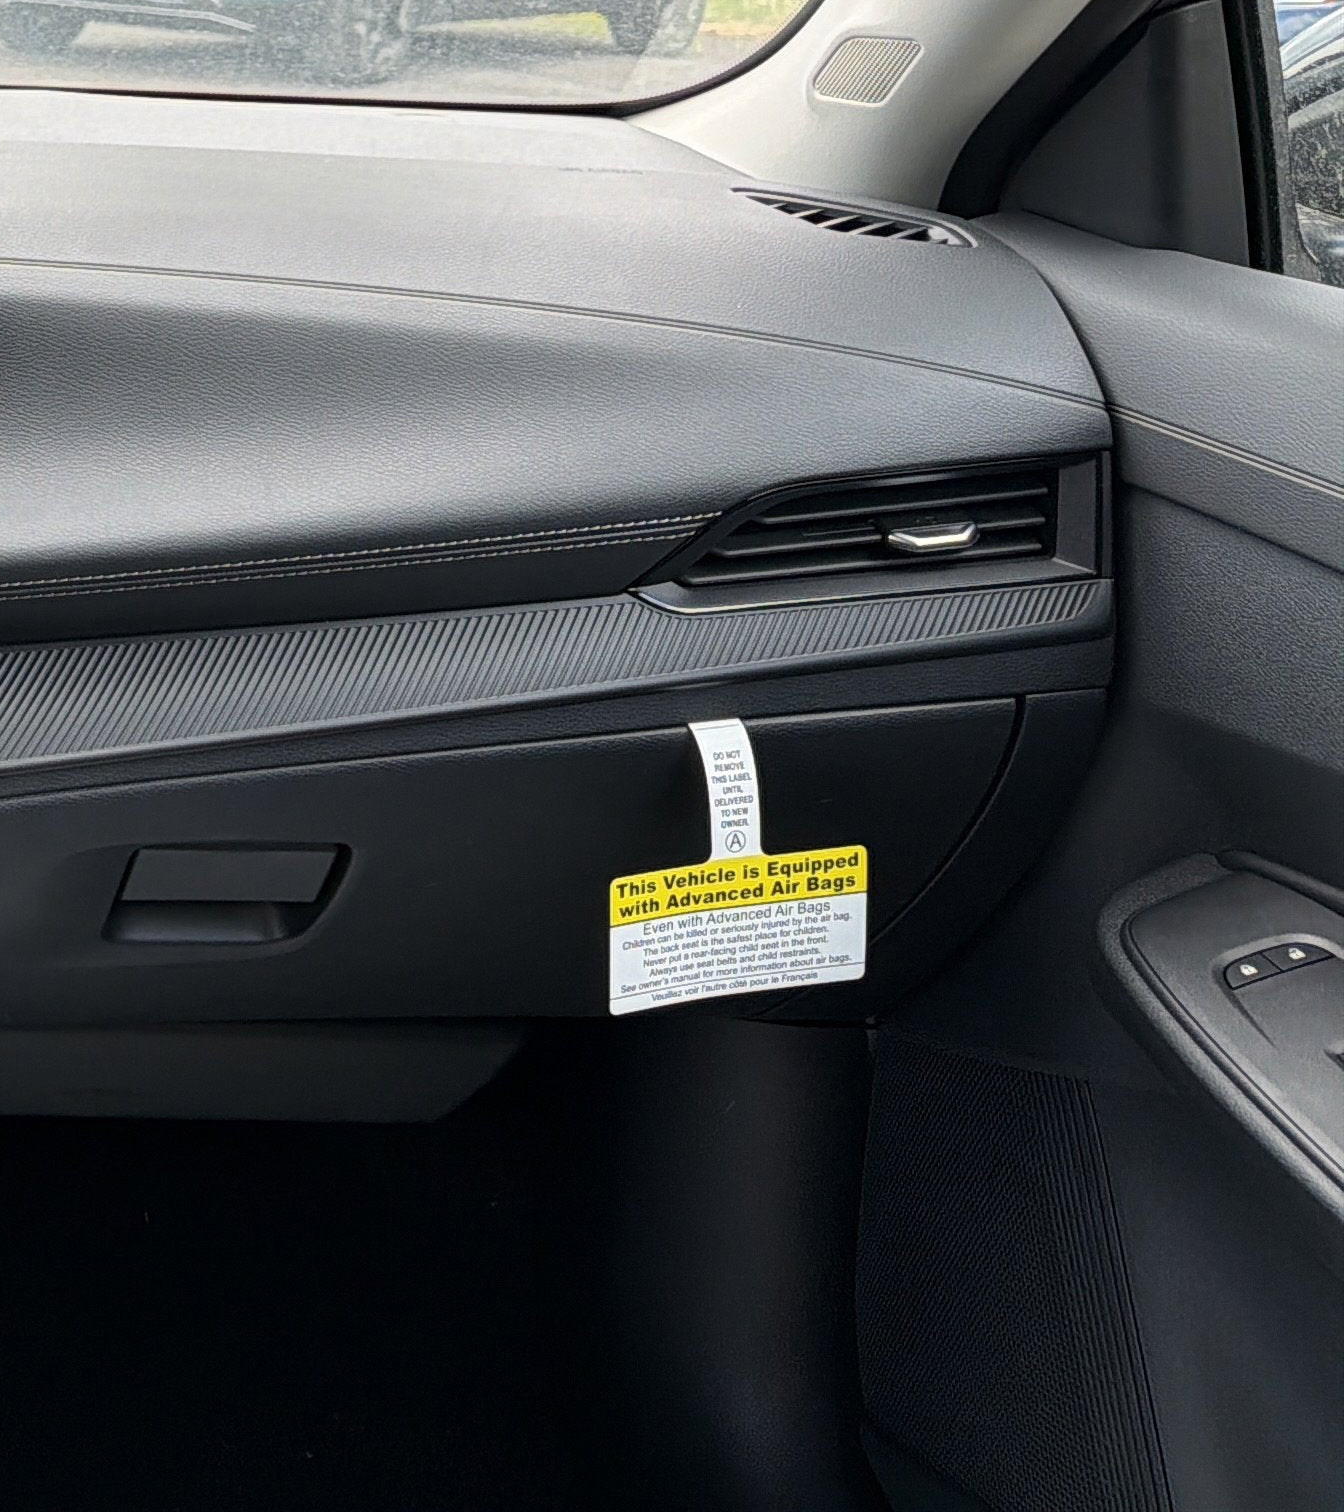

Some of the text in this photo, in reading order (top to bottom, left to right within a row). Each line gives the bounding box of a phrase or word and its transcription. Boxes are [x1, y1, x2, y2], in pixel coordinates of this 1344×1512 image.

[713, 750, 741, 761] DO NOT
[712, 773, 752, 784] THIS LABEL
[714, 795, 753, 807] DELIVERED
[721, 807, 749, 817] TO NEW
[616, 851, 859, 899] This Vehicle is Equipped
[619, 875, 856, 918] with Advanced Air Bags
[622, 911, 853, 951] Children can be killed or seriously injured by the air bag.
[643, 901, 831, 936] Even with Advanced Air Bags
[643, 925, 830, 957] The back seat is the safest place for children.
[643, 935, 828, 968] Never put a rear-facing child seat in the front.
[621, 954, 853, 994] See owner's manual for more information about air bags.
[649, 947, 821, 977] Always use seat belts and child restraints.
[651, 989, 683, 1002] Veuillez
[684, 985, 699, 995] voir
[749, 977, 769, 987] pour
[771, 975, 779, 984] le
[781, 971, 819, 983] Français
